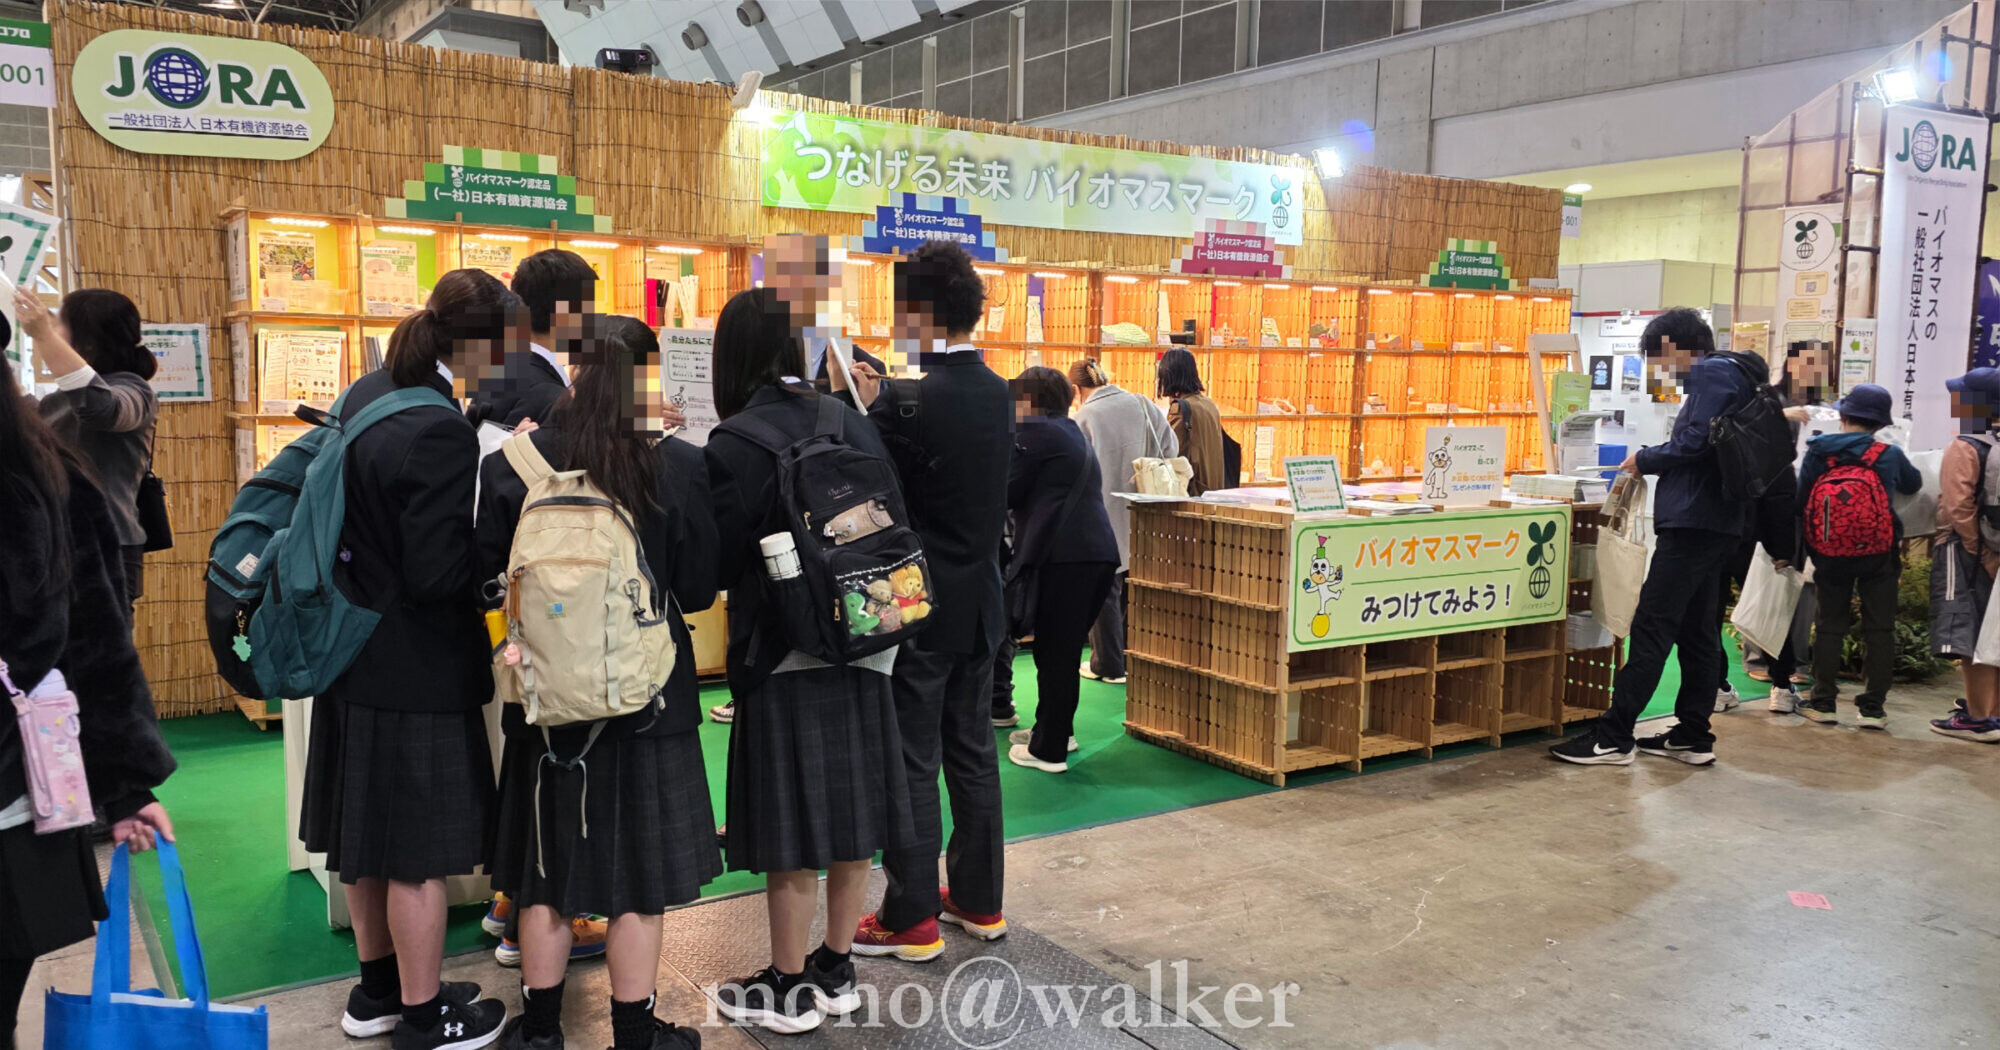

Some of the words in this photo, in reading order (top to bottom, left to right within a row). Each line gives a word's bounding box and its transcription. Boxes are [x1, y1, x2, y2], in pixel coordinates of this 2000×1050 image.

[105, 47, 306, 110] JORA
[109, 113, 197, 131] 一般社団法人
[200, 118, 308, 137] 日本有機資源協会
[1895, 120, 1977, 173] JORA
[465, 172, 551, 191] バイオマスマーク認定品
[796, 145, 1011, 200] つなげる未来
[1024, 166, 1256, 221] バイオマスマーク
[1925, 205, 1949, 341] バイオマスの
[1355, 529, 1520, 568] バイオマスマーク
[1361, 584, 1511, 623] みつけてみよう！
